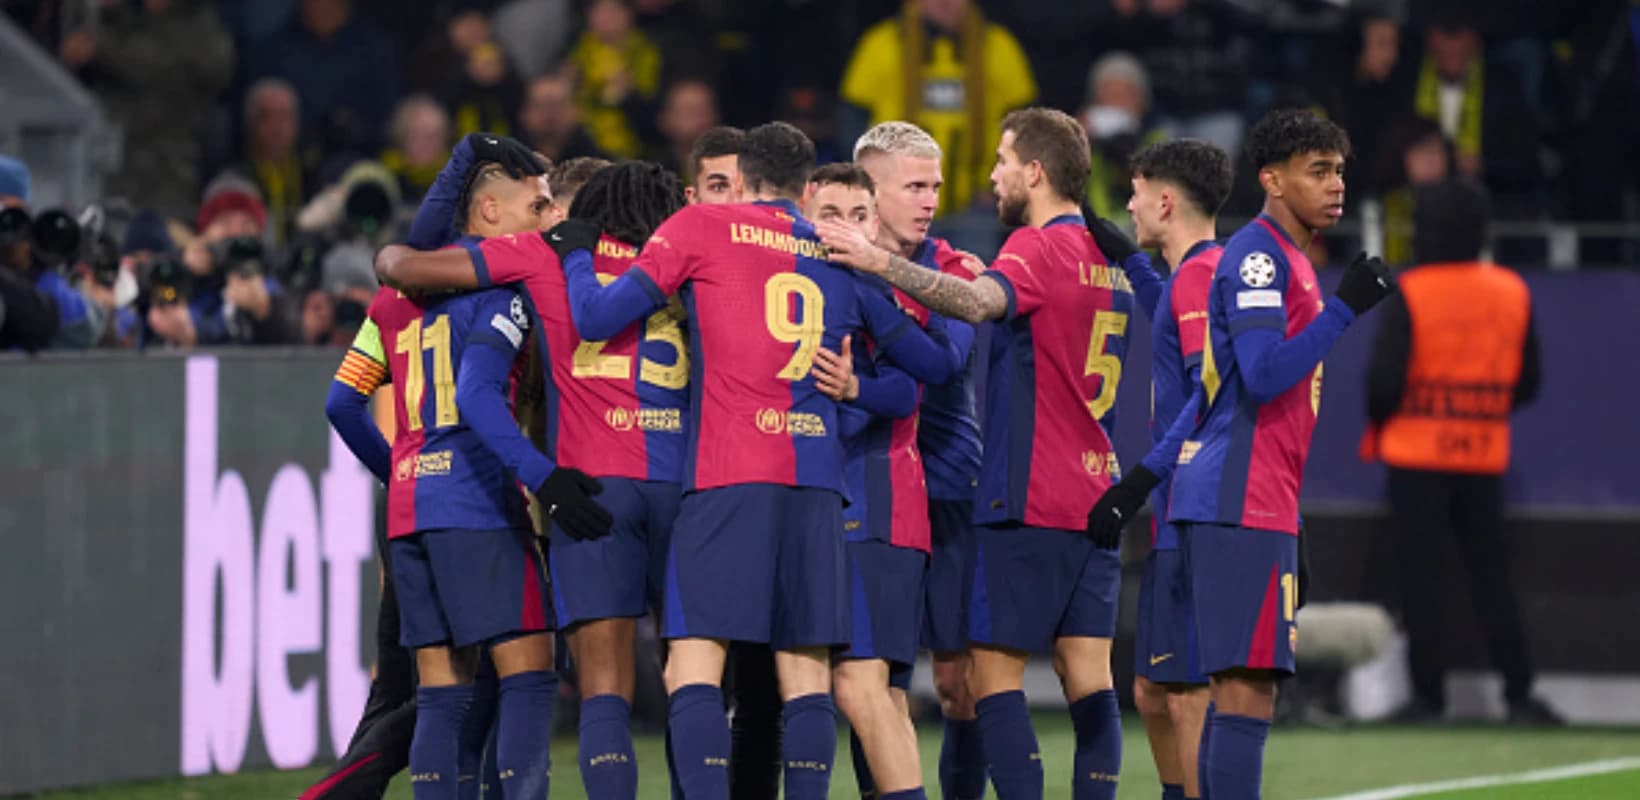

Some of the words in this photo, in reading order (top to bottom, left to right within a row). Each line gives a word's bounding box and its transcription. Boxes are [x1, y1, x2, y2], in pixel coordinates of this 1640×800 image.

[396, 314, 459, 431] 11
[764, 272, 825, 381] 9
[1084, 310, 1128, 421] 5
[180, 355, 373, 777] bet
